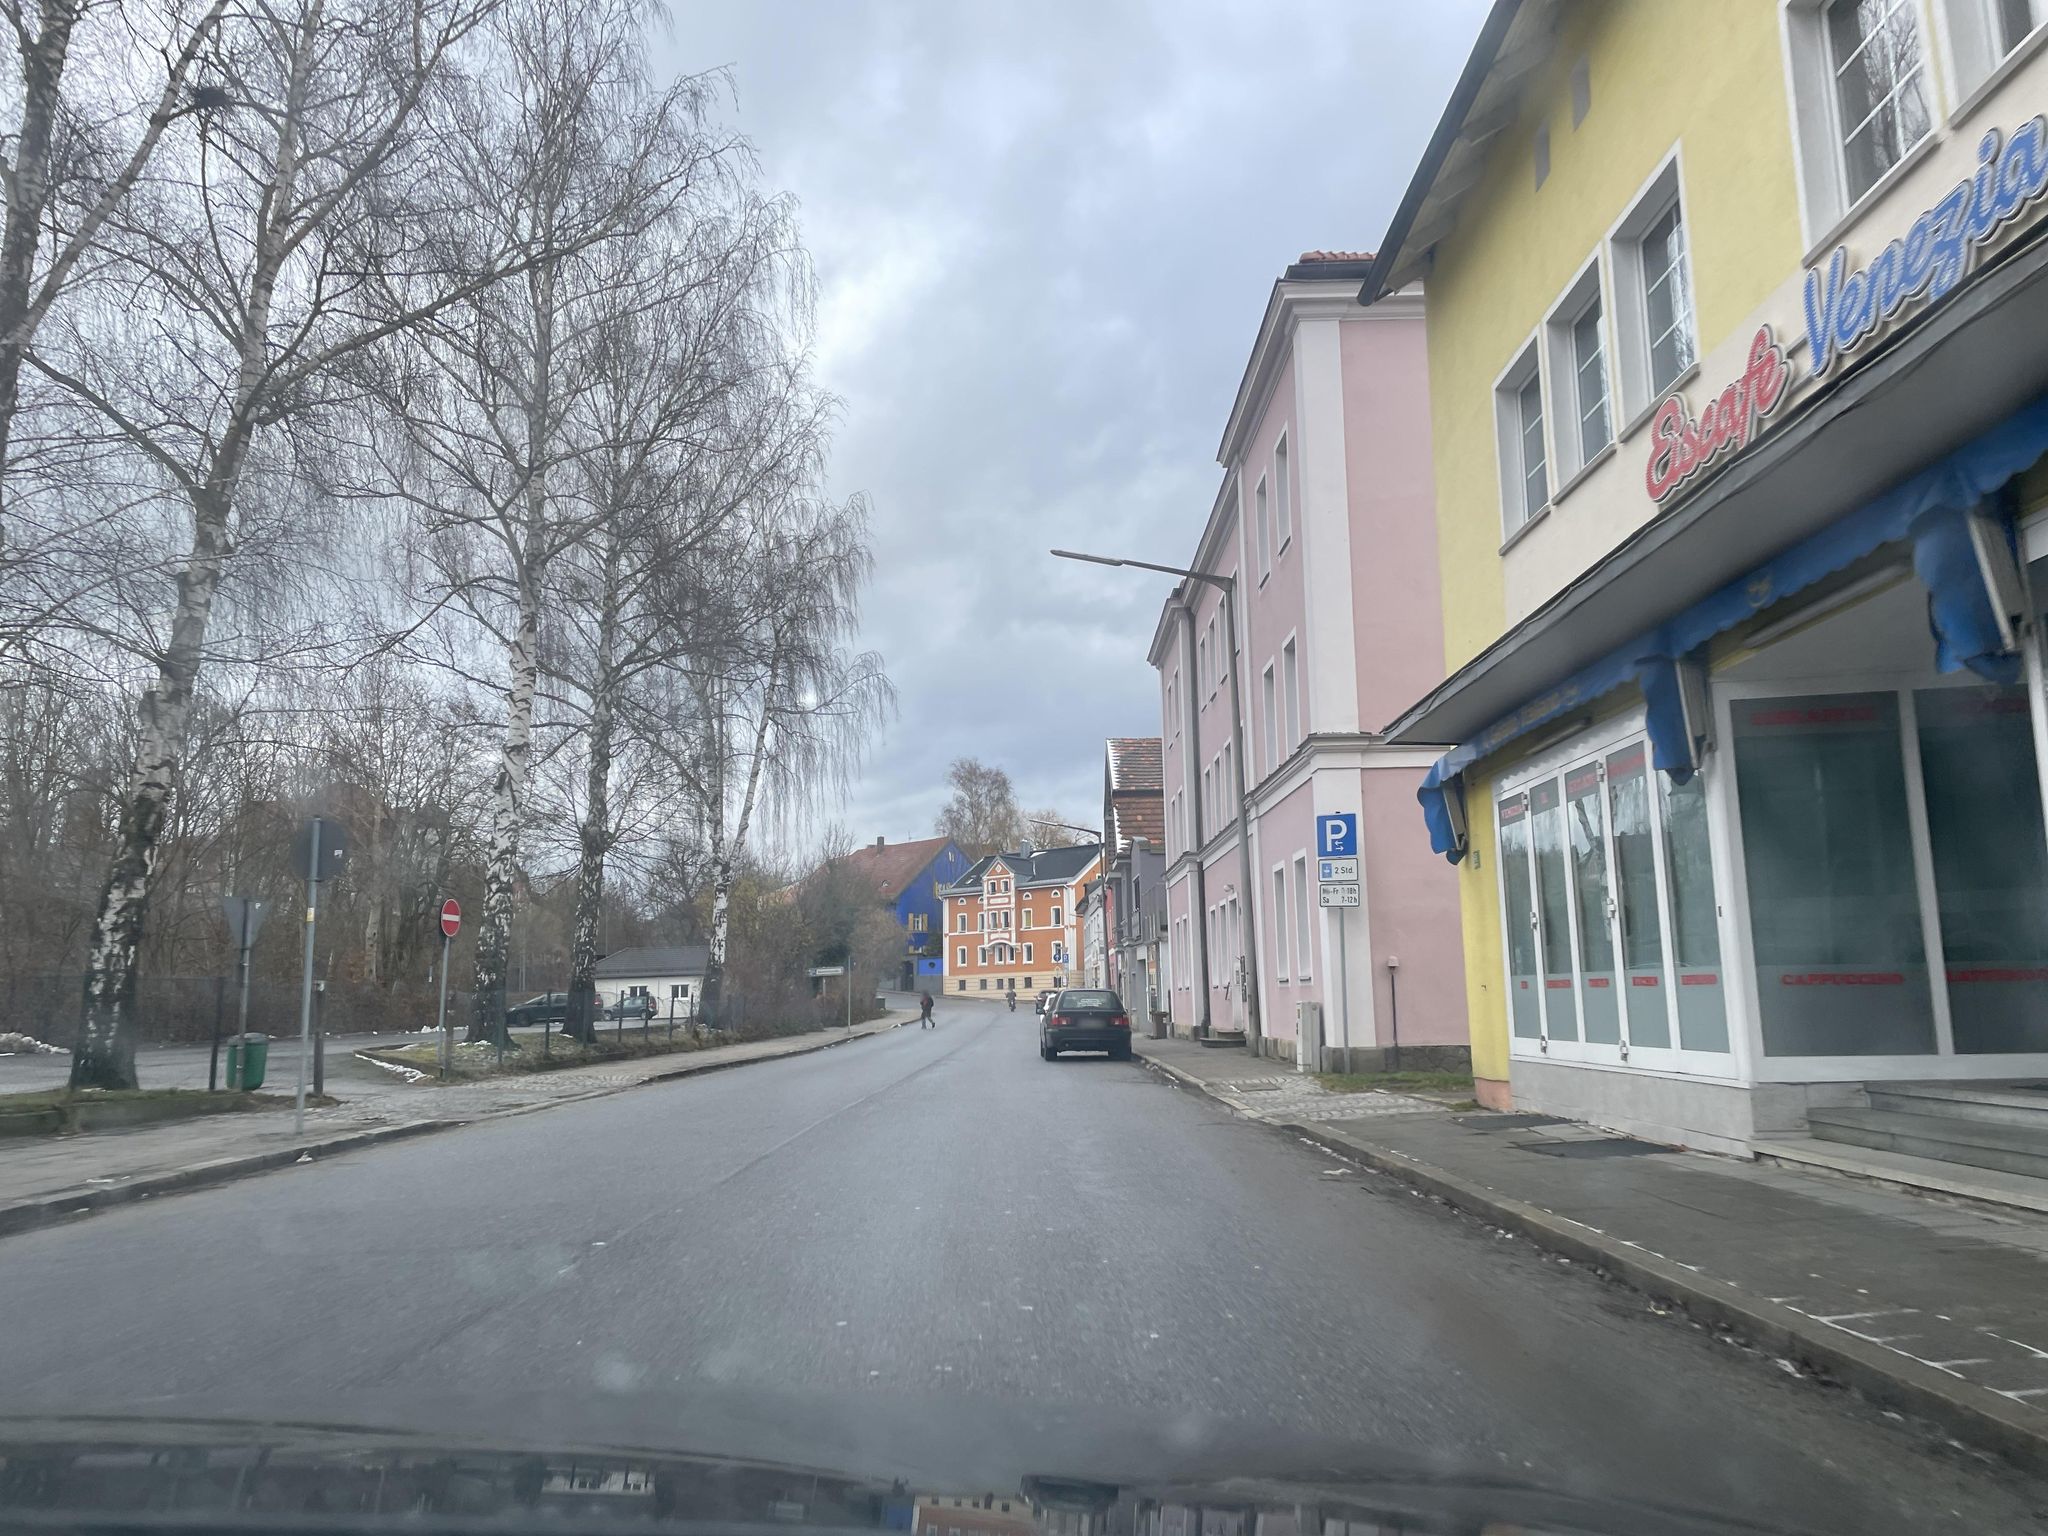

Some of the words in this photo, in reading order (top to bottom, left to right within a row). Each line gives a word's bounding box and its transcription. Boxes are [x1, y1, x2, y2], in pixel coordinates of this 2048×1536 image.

[1803, 115, 2048, 378] Venezia
[1326, 820, 1347, 852] P
[1322, 896, 1330, 904] Sa
